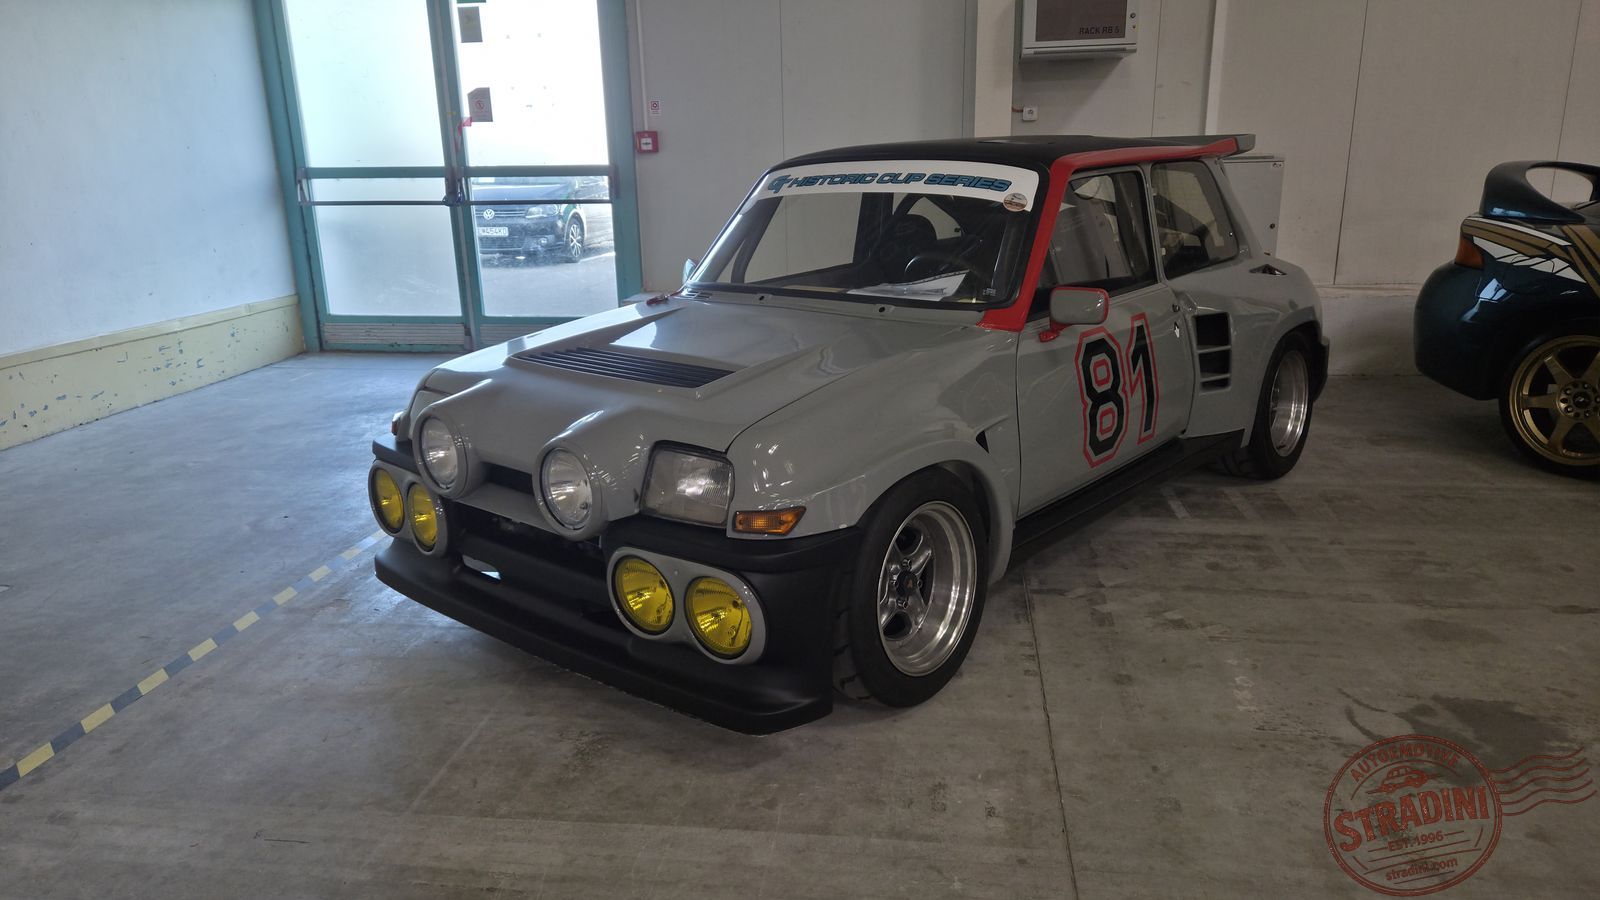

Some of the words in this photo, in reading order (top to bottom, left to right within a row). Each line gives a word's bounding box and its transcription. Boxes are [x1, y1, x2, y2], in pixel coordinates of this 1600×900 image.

[1079, 26, 1100, 35] RACK
[787, 172, 879, 189] HISTORIC
[876, 172, 926, 185] CUP
[923, 173, 1013, 192] SERIES
[1075, 313, 1159, 467] 81
